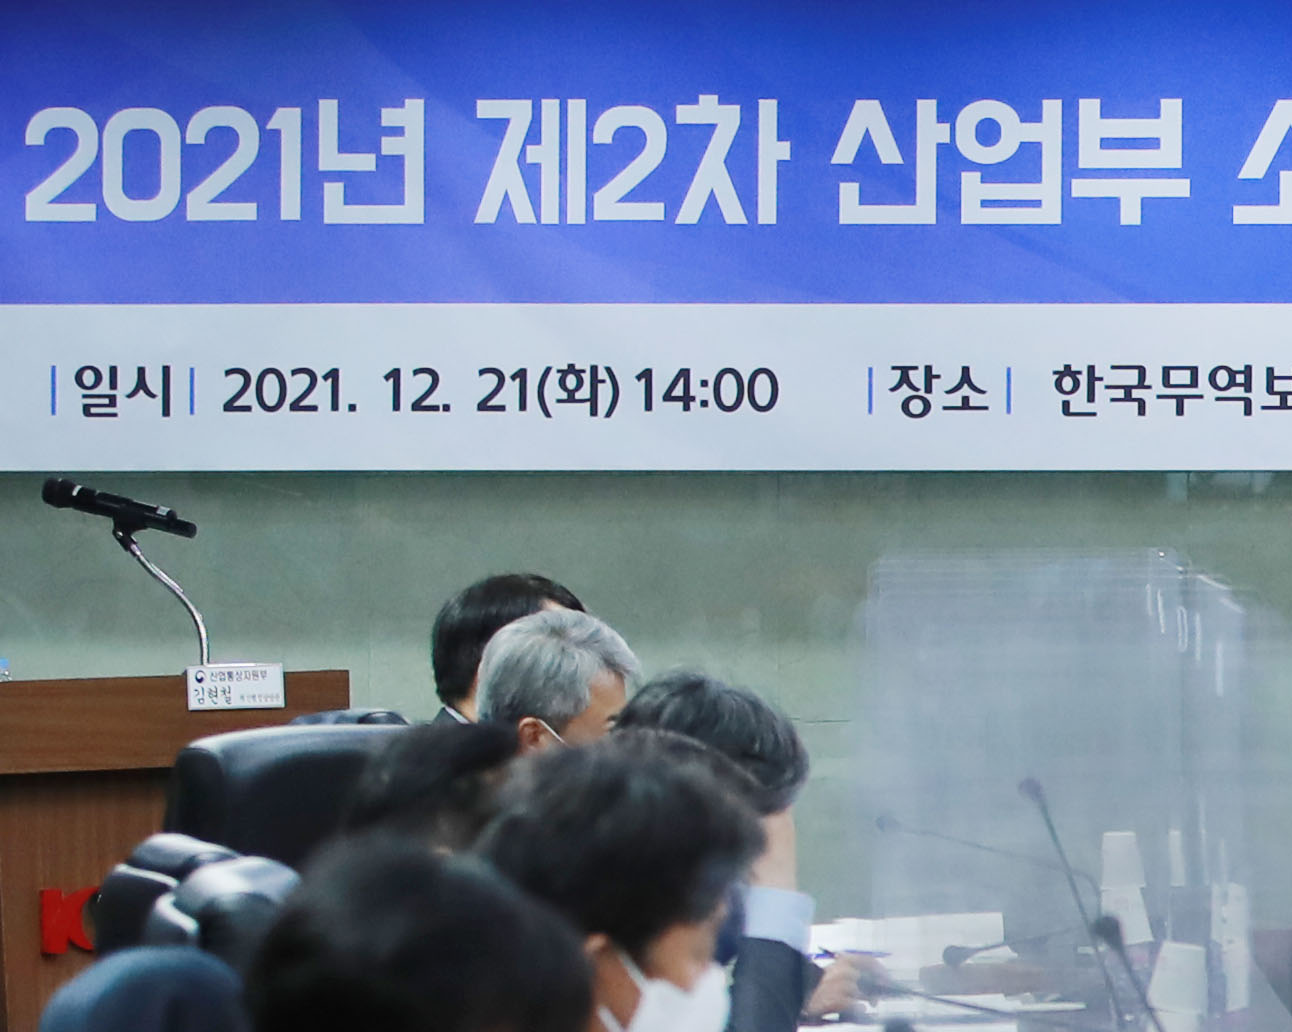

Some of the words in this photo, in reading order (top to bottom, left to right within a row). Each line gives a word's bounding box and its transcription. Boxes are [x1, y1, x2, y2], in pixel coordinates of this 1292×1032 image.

[25, 98, 425, 225] 2021년
[473, 94, 791, 225] 제2차
[830, 98, 1191, 226] 산업부
[74, 365, 171, 418] 일시
[222, 367, 357, 413] 2021.
[383, 367, 451, 413] 12.
[476, 363, 620, 419] 21(화)
[635, 367, 779, 413] 14:00
[888, 364, 990, 419] 장소
[210, 670, 268, 682] 산업통상자원부
